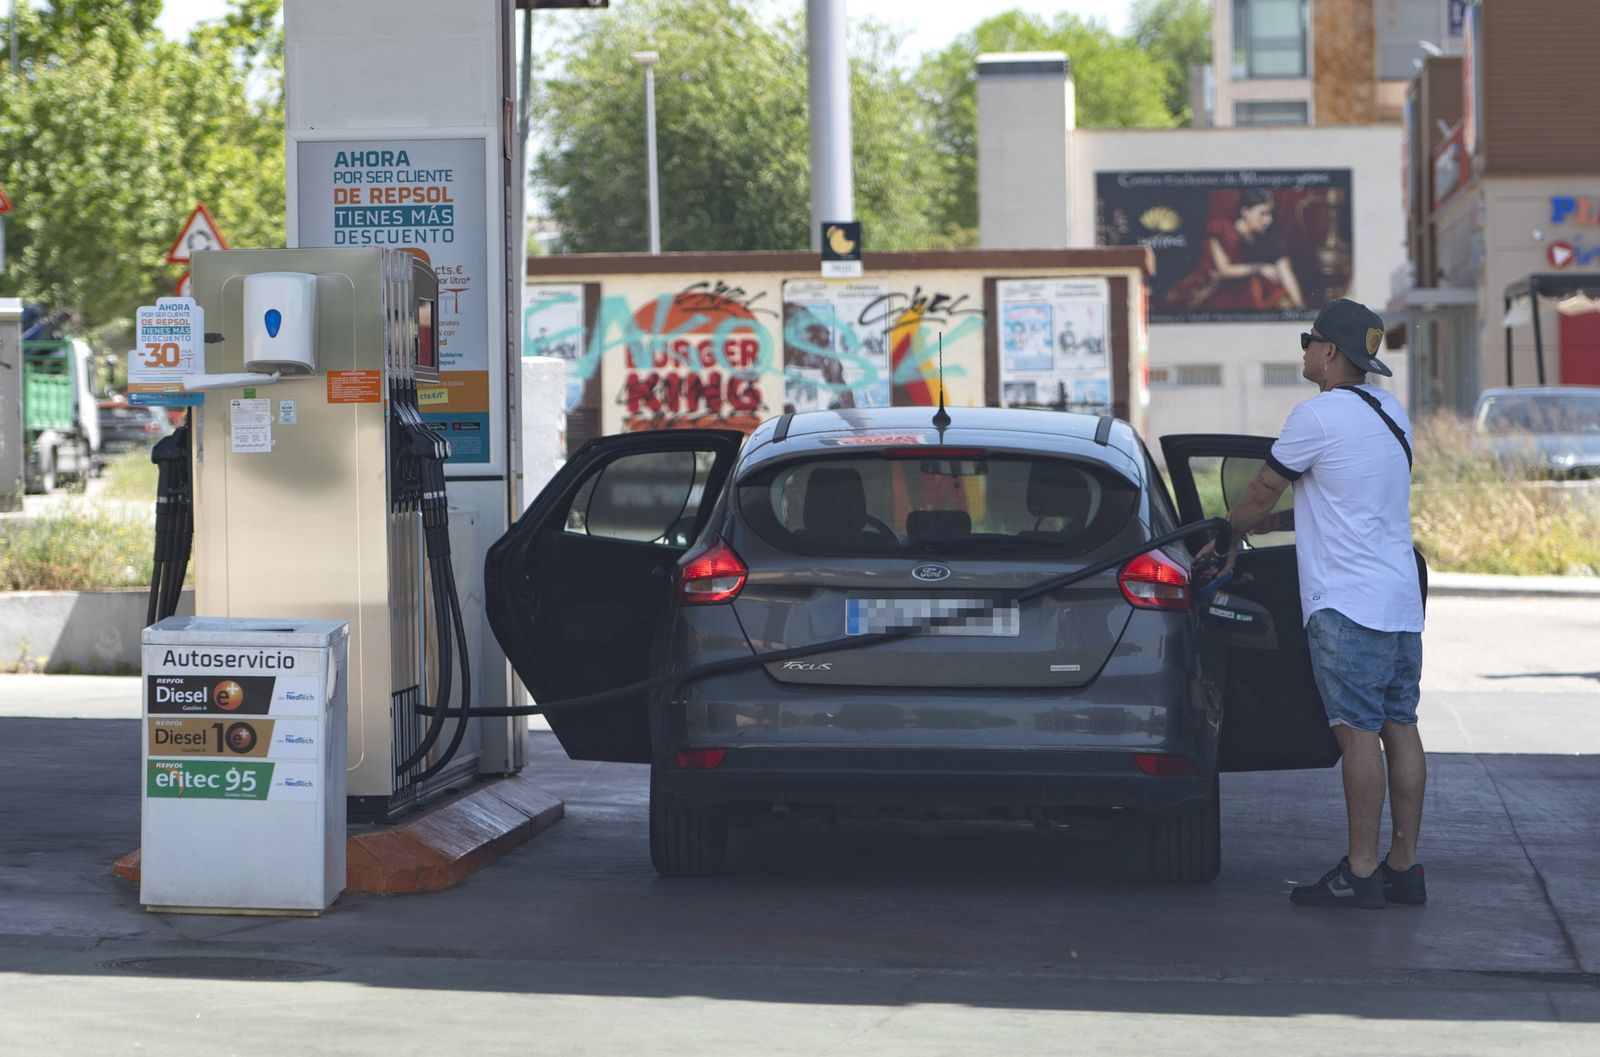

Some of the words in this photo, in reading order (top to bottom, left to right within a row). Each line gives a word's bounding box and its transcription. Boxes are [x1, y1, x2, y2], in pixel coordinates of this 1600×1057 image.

[334, 150, 411, 168] AHORA
[333, 171, 363, 184] POR
[366, 170, 393, 183] SER
[396, 169, 454, 183] CLIENTE
[333, 187, 362, 205] DE
[369, 186, 454, 204] REPSOL
[335, 209, 404, 225] TIENES
[411, 205, 453, 225] MÁS
[1550, 196, 1600, 225] PL
[334, 228, 455, 245] DESCUENTO
[434, 264, 464, 275] cts.€
[158, 303, 190, 311] AHORA
[141, 318, 153, 326] DE
[156, 318, 191, 326] REPSOL
[138, 342, 180, 368] -30
[625, 371, 762, 413] KING
[920, 567, 943, 578] Ford
[162, 650, 295, 670] Autoservicio
[156, 686, 208, 703] Diesel
[155, 728, 207, 745] Diesel
[155, 771, 220, 789] efitec
[224, 769, 257, 792] 95
